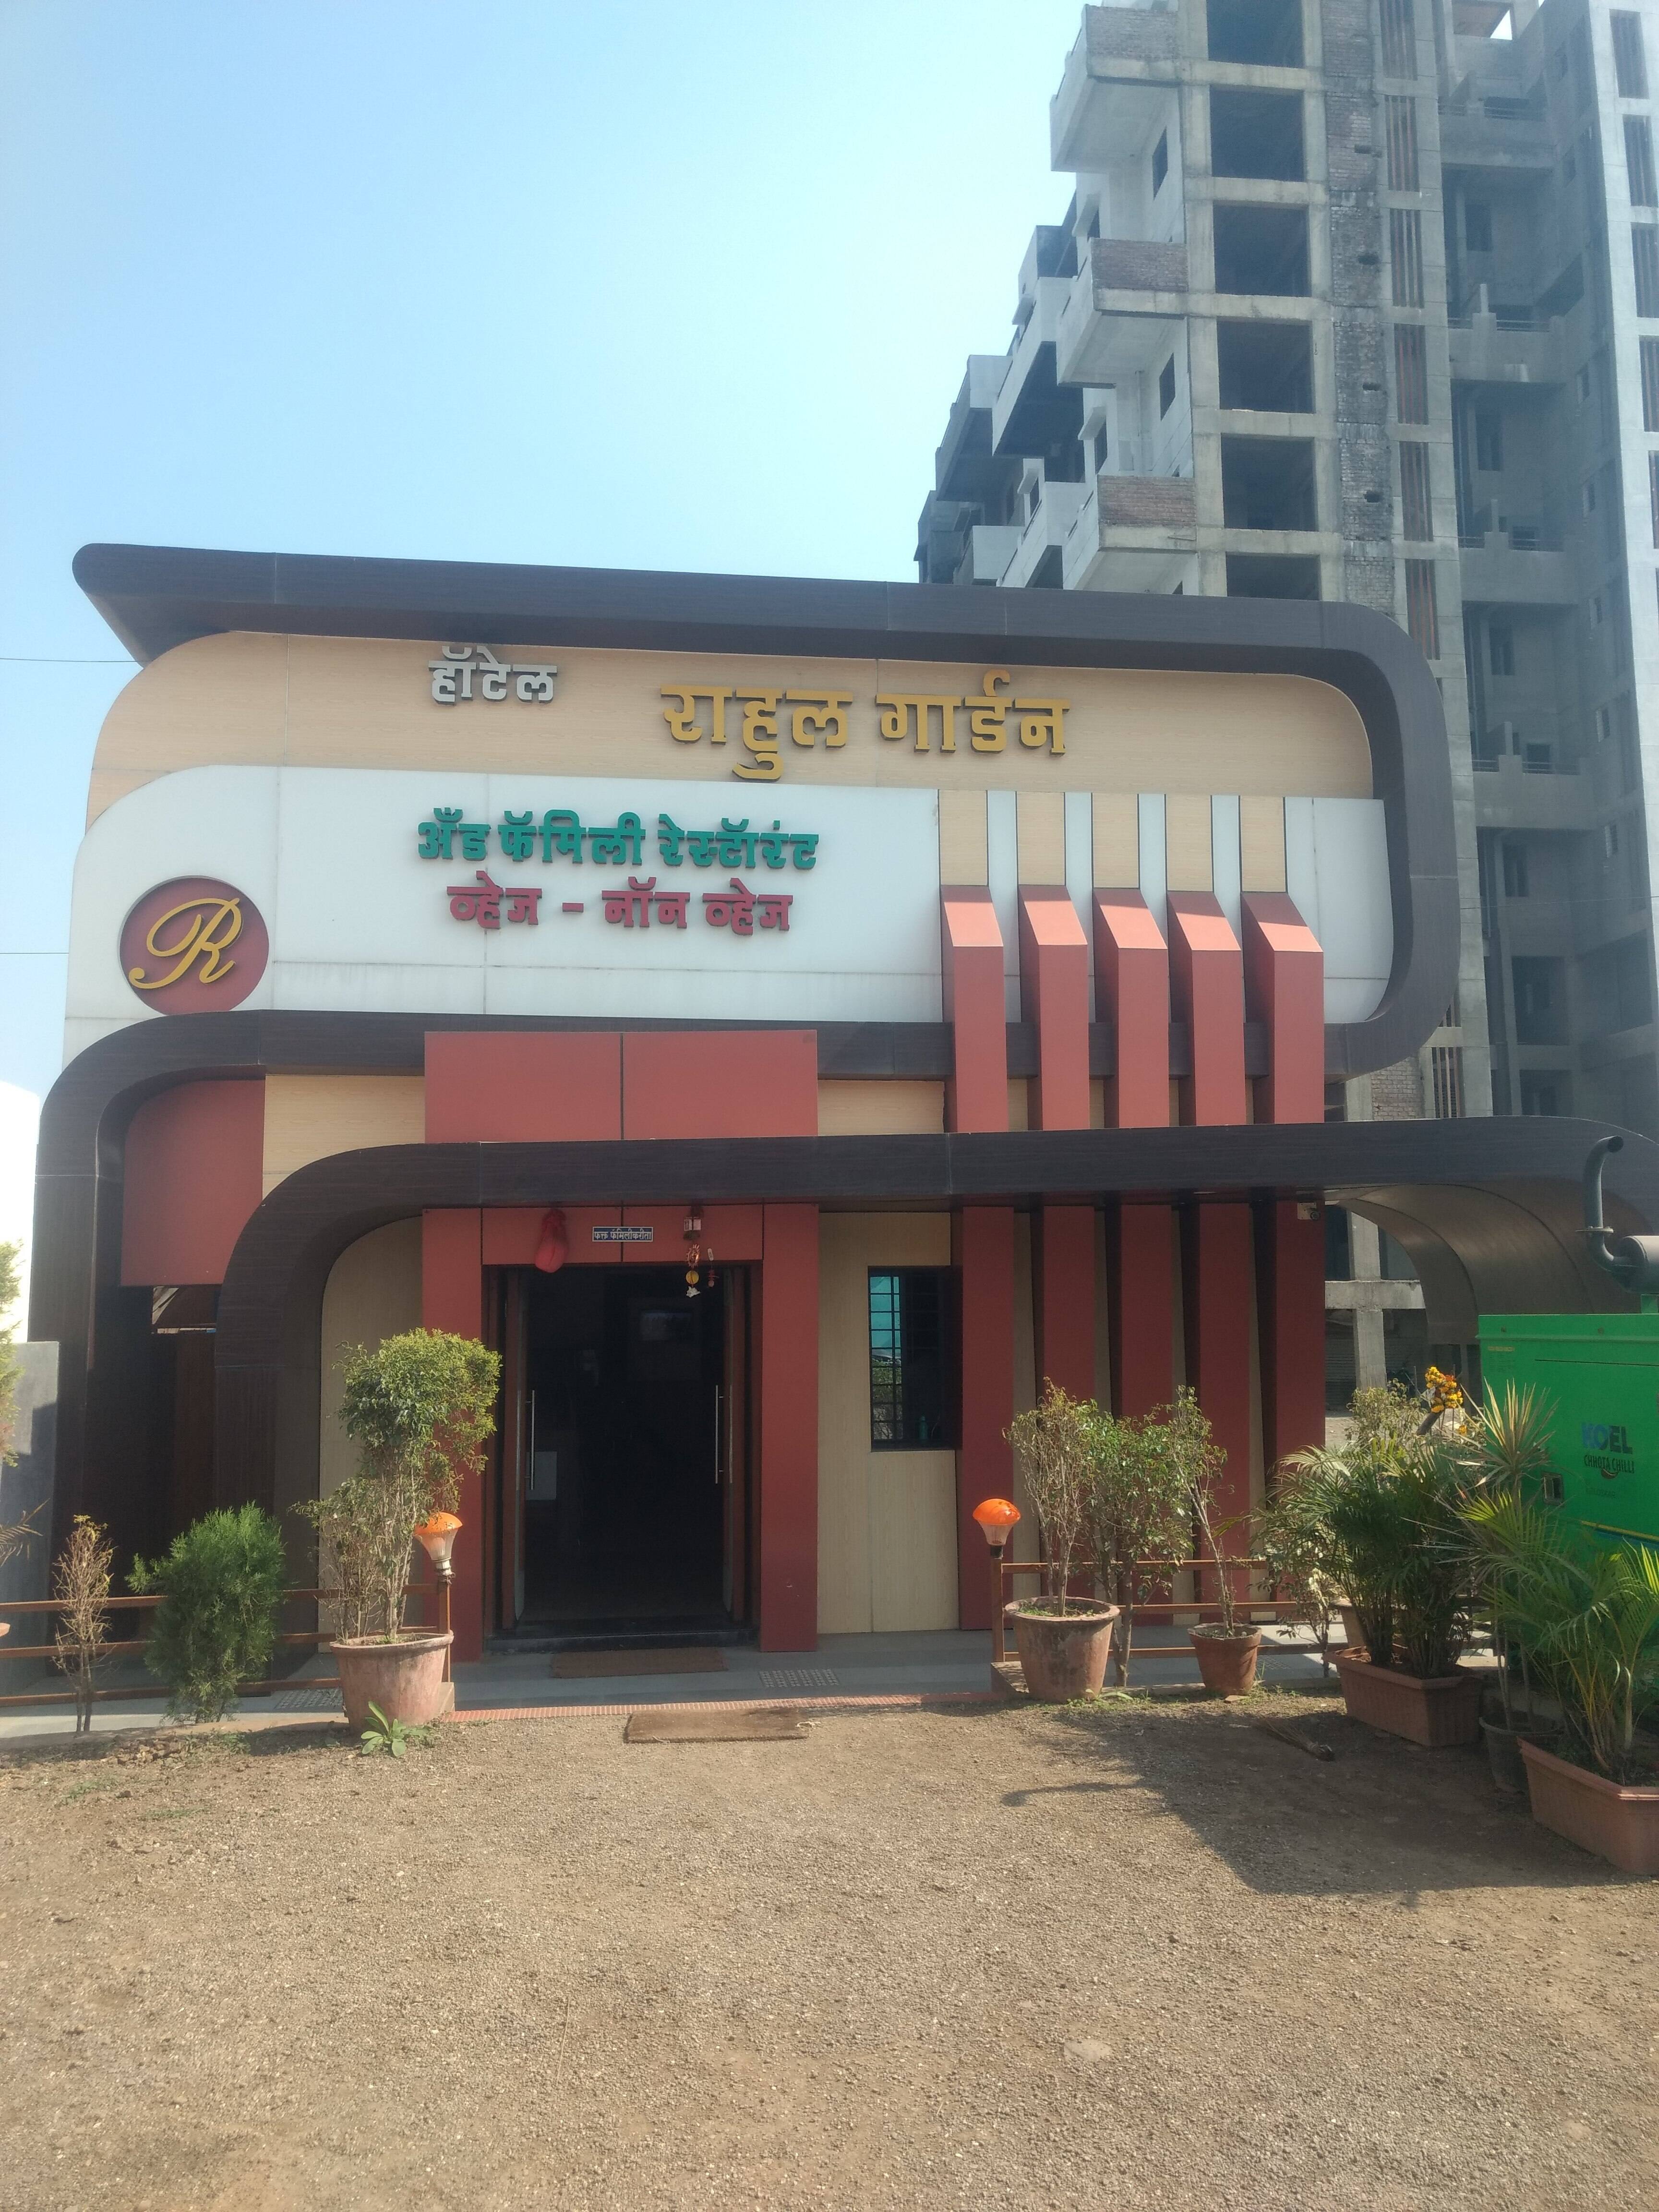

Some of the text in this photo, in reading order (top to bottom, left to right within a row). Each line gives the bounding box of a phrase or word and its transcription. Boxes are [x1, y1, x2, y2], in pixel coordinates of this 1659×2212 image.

[428, 645, 1070, 781] हॉटेल राहुल गार्डन
[498, 809, 646, 865] फॅमिली
[658, 814, 819, 869] रेस्टॉरंट
[446, 870, 543, 929] व्हेज
[601, 877, 691, 928] नॉन
[702, 878, 794, 936] व्हेज
[128, 898, 242, 989] R
[1582, 1423, 1633, 1455] KOEL
[1584, 1455, 1635, 1474] CHHOTA CHILLI
